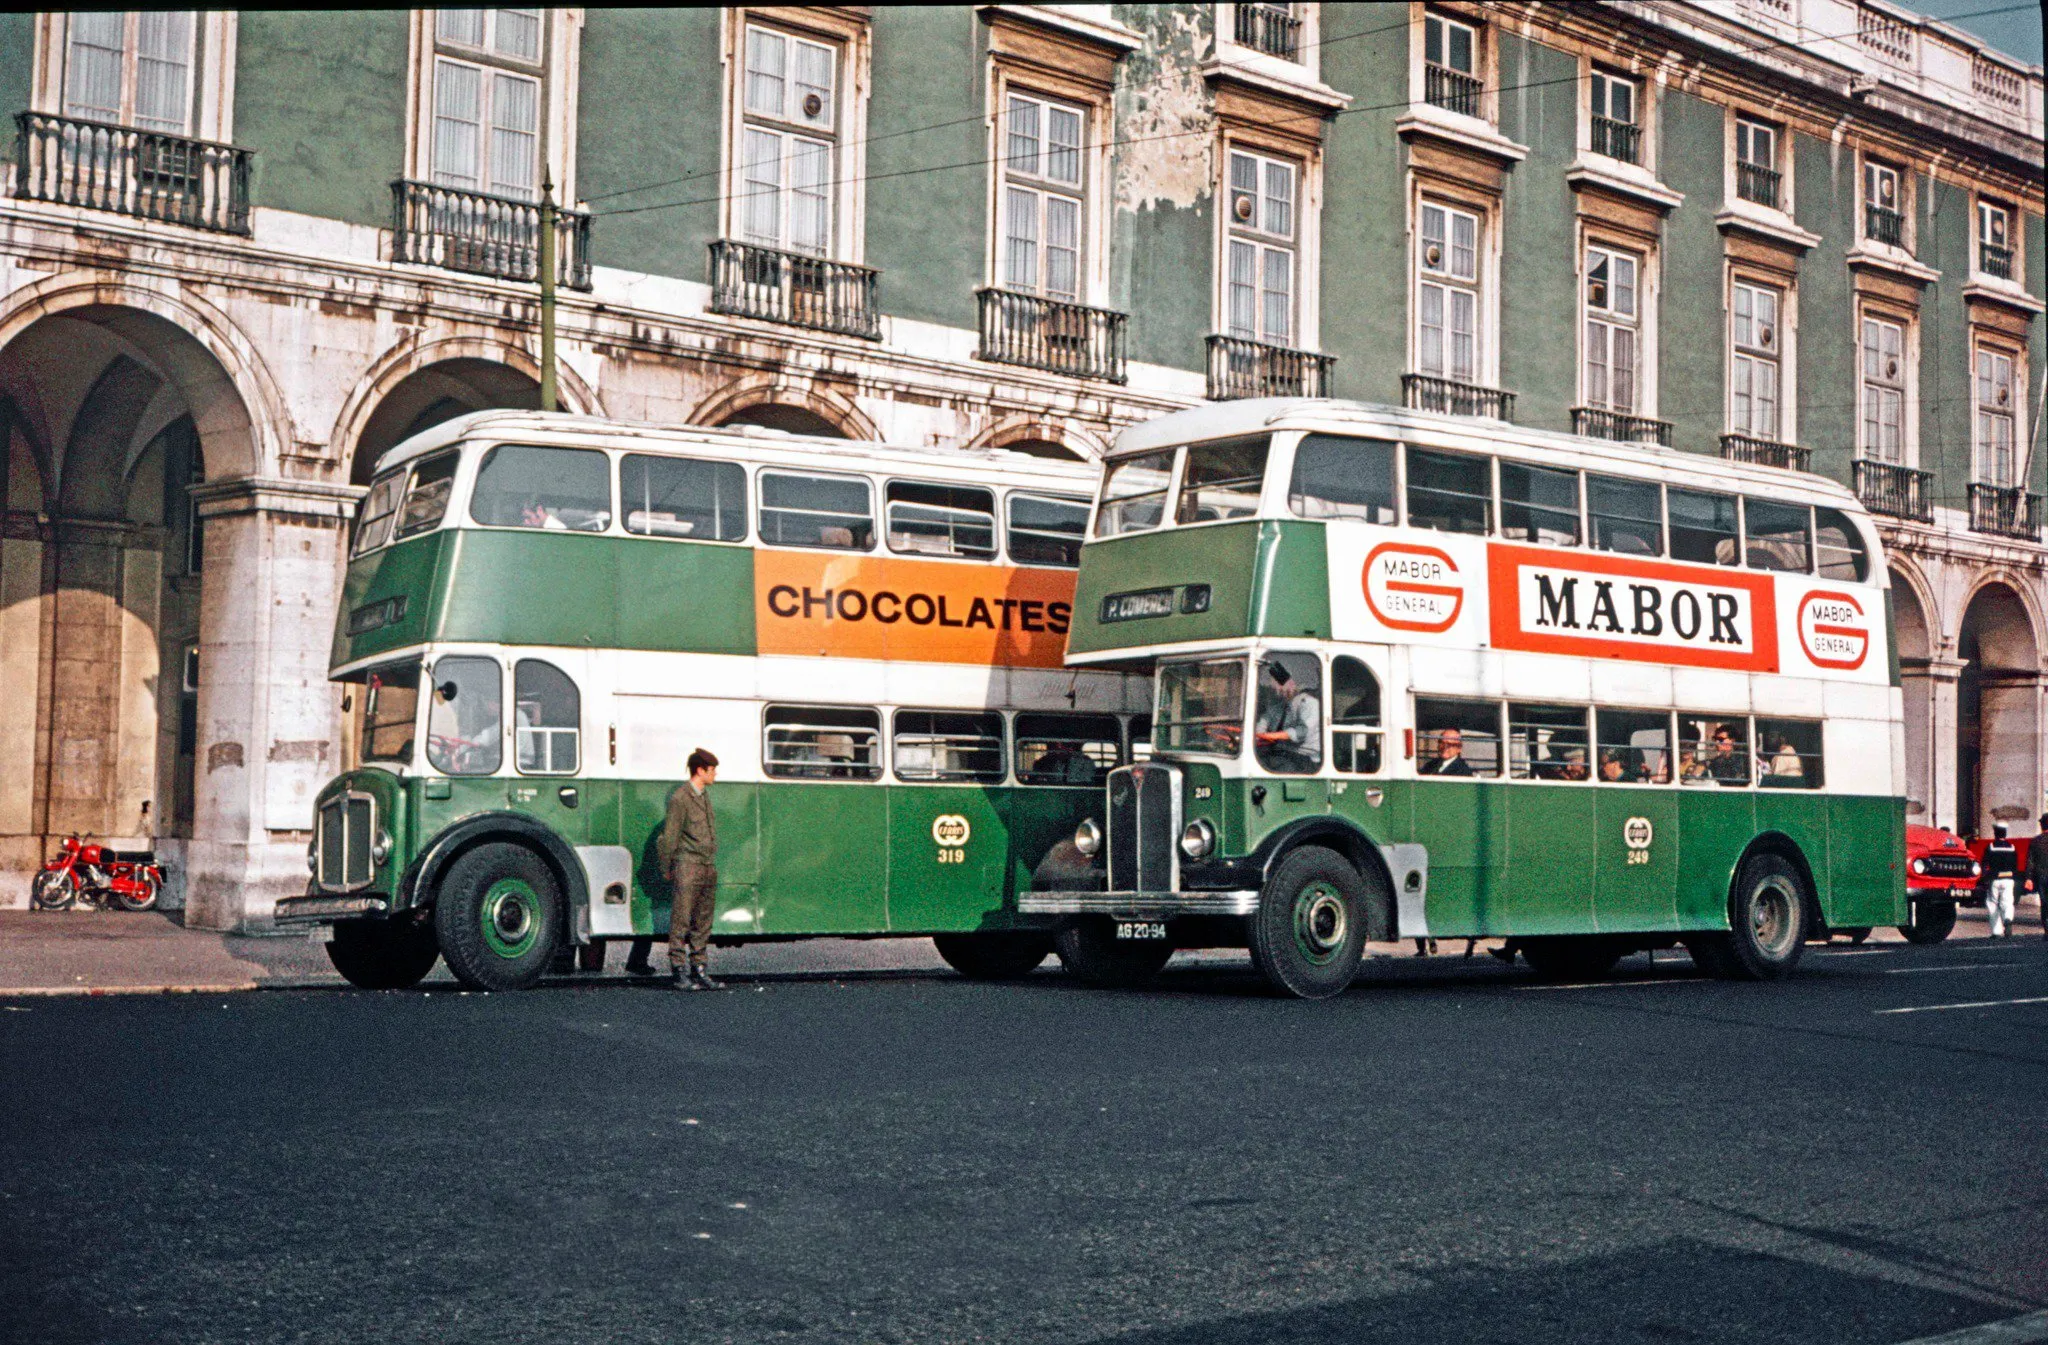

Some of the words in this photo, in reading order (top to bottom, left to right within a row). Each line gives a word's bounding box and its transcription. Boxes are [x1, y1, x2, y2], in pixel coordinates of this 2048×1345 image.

[1384, 559, 1441, 580] MABOR
[767, 584, 1072, 634] CHOCOLATES
[1386, 595, 1442, 615] GENERAL
[1534, 573, 1743, 645] MABOR
[1812, 604, 1854, 623] MABOR
[1814, 637, 1856, 654] GENERAL
[937, 849, 965, 864] 319
[1627, 850, 1649, 865] 249
[1116, 923, 1133, 939] AG
[1134, 923, 1166, 939] 20-94
